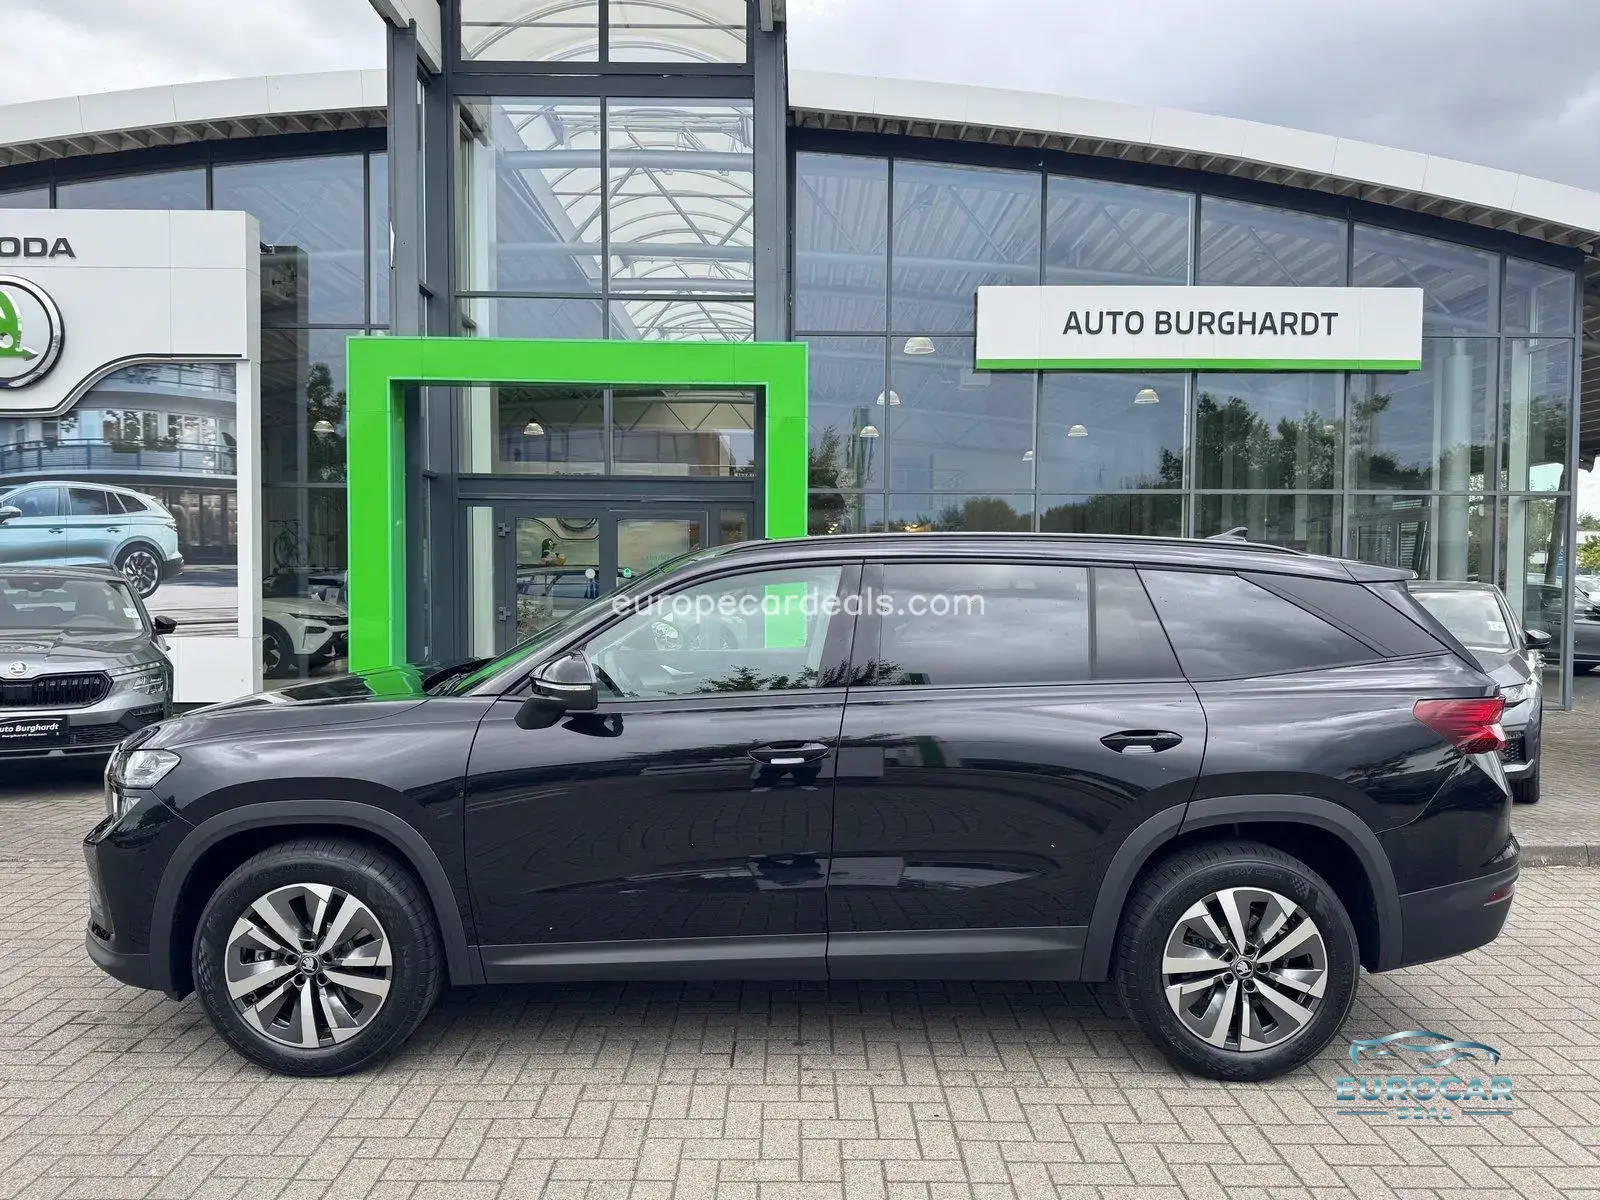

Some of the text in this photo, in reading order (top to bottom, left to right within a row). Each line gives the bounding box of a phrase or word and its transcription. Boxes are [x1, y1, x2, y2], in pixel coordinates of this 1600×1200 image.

[1062, 311, 1339, 336] AUTO BURGHARDT
[15, 723, 60, 733] Burghardt
